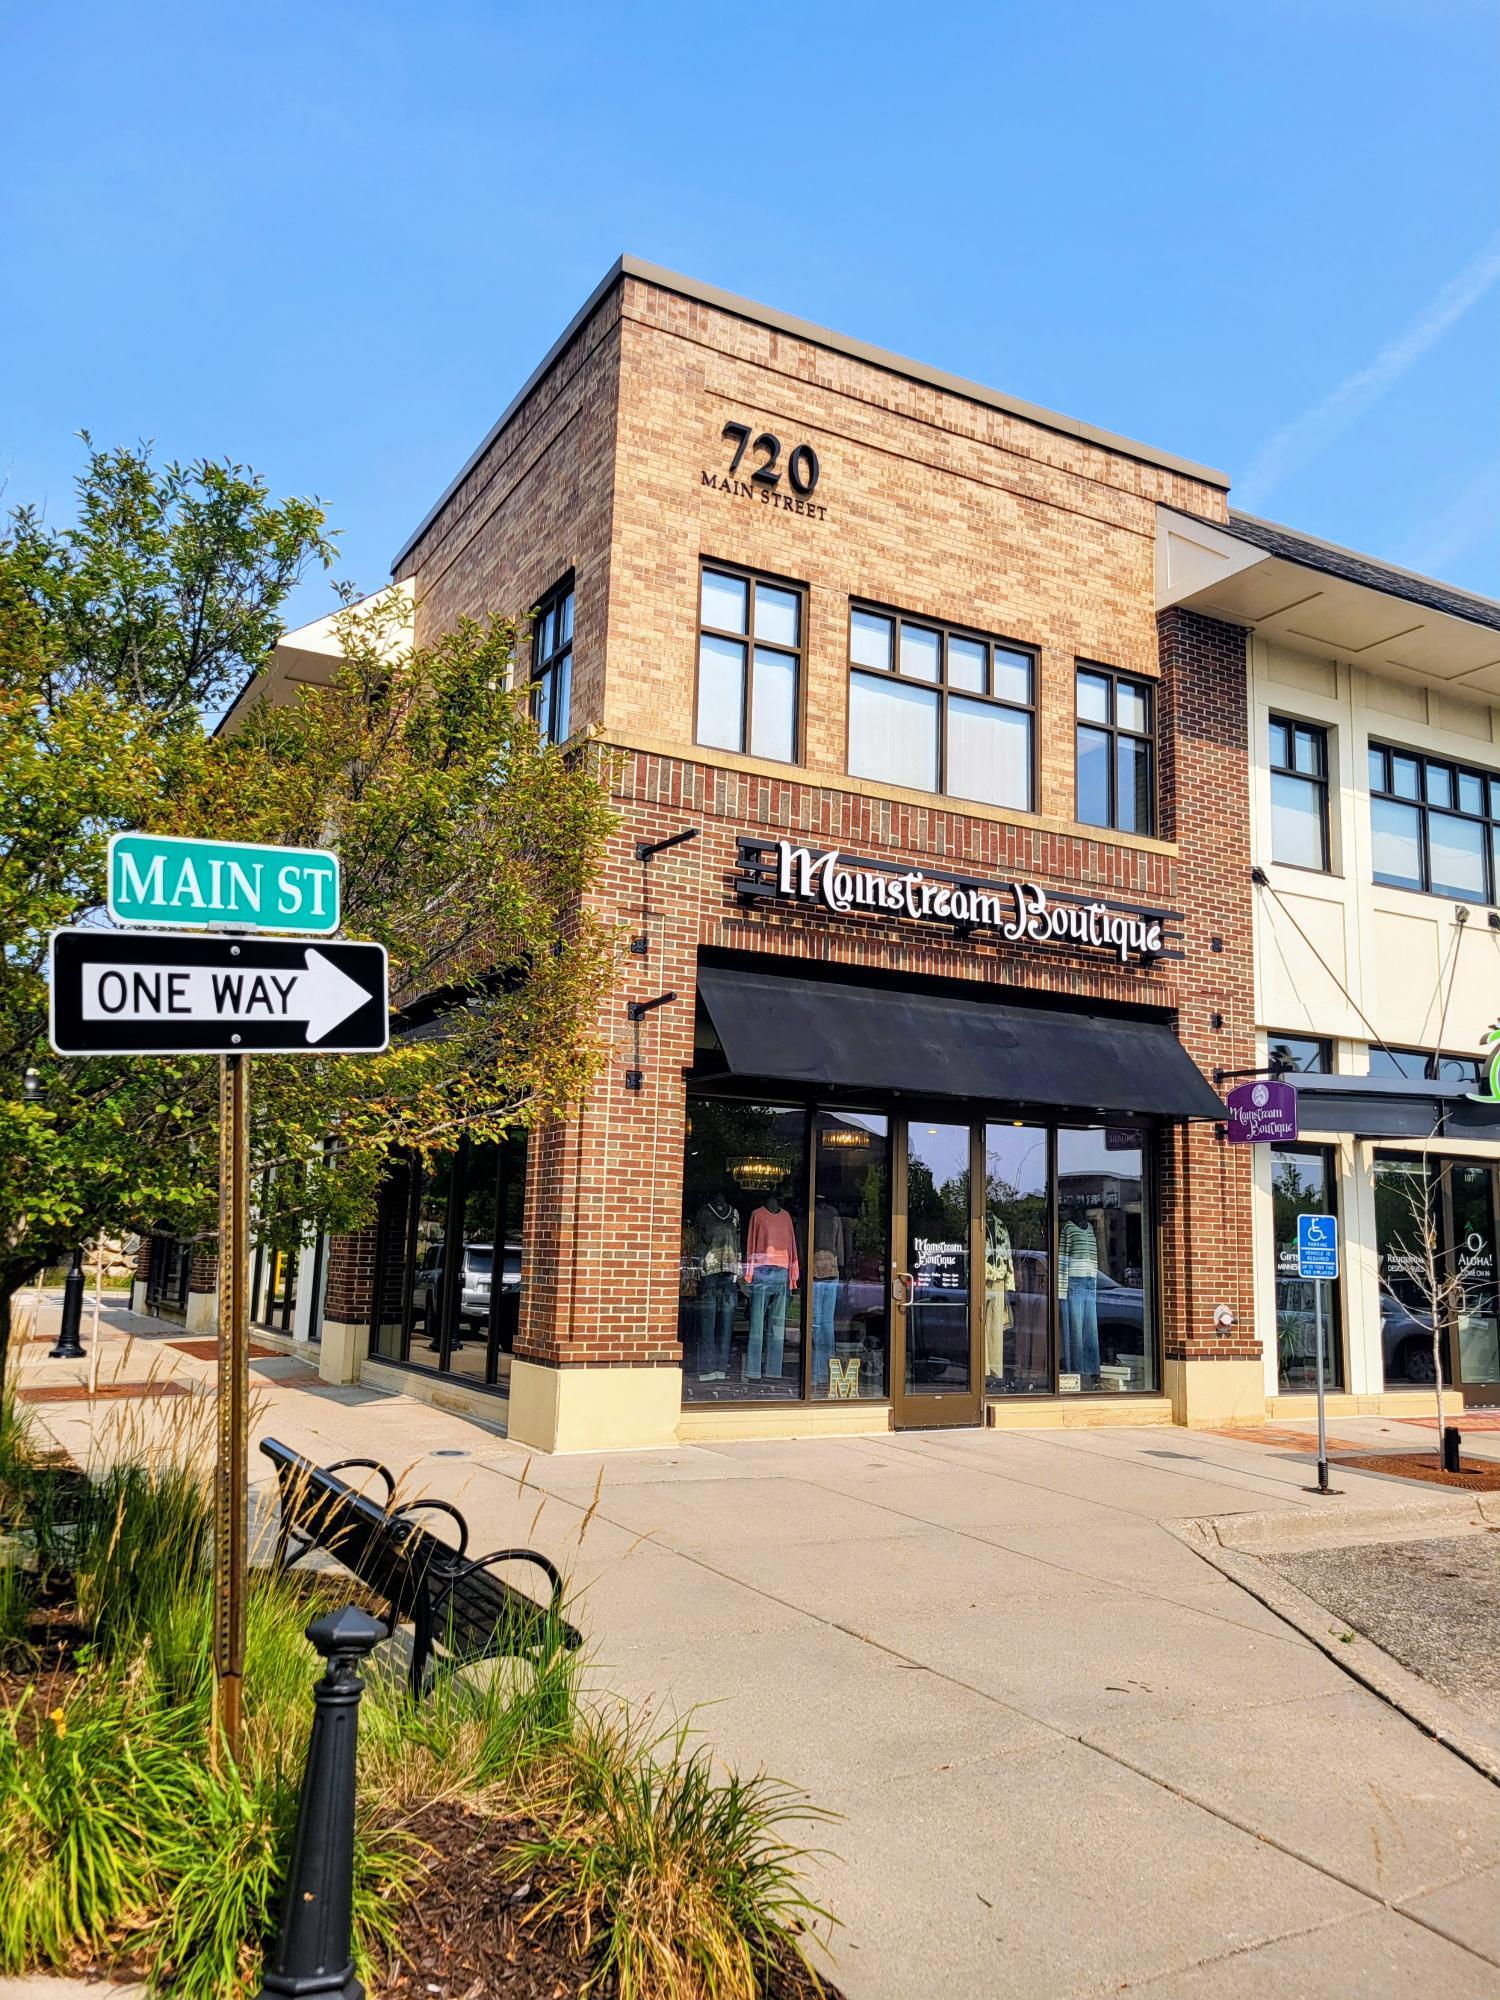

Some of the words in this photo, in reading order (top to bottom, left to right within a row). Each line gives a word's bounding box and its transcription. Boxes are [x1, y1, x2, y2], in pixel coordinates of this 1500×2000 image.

[722, 421, 819, 495] 720
[701, 471, 754, 500] MAIN
[761, 490, 827, 521] STREET
[117, 852, 264, 912] MAIN
[277, 865, 333, 916] ST
[779, 840, 1002, 927] Mainstream
[1003, 882, 1162, 962] Boutique
[97, 970, 192, 1014] ONE
[211, 974, 298, 1014] WAY
[1229, 1106, 1283, 1126] Mainstream
[1246, 1120, 1293, 1140] Boutique
[914, 1237, 962, 1256] Mainstream
[914, 1250, 956, 1269] Boutique
[1458, 1253, 1493, 1266] ALOHA!
[828, 1358, 861, 1398] M
